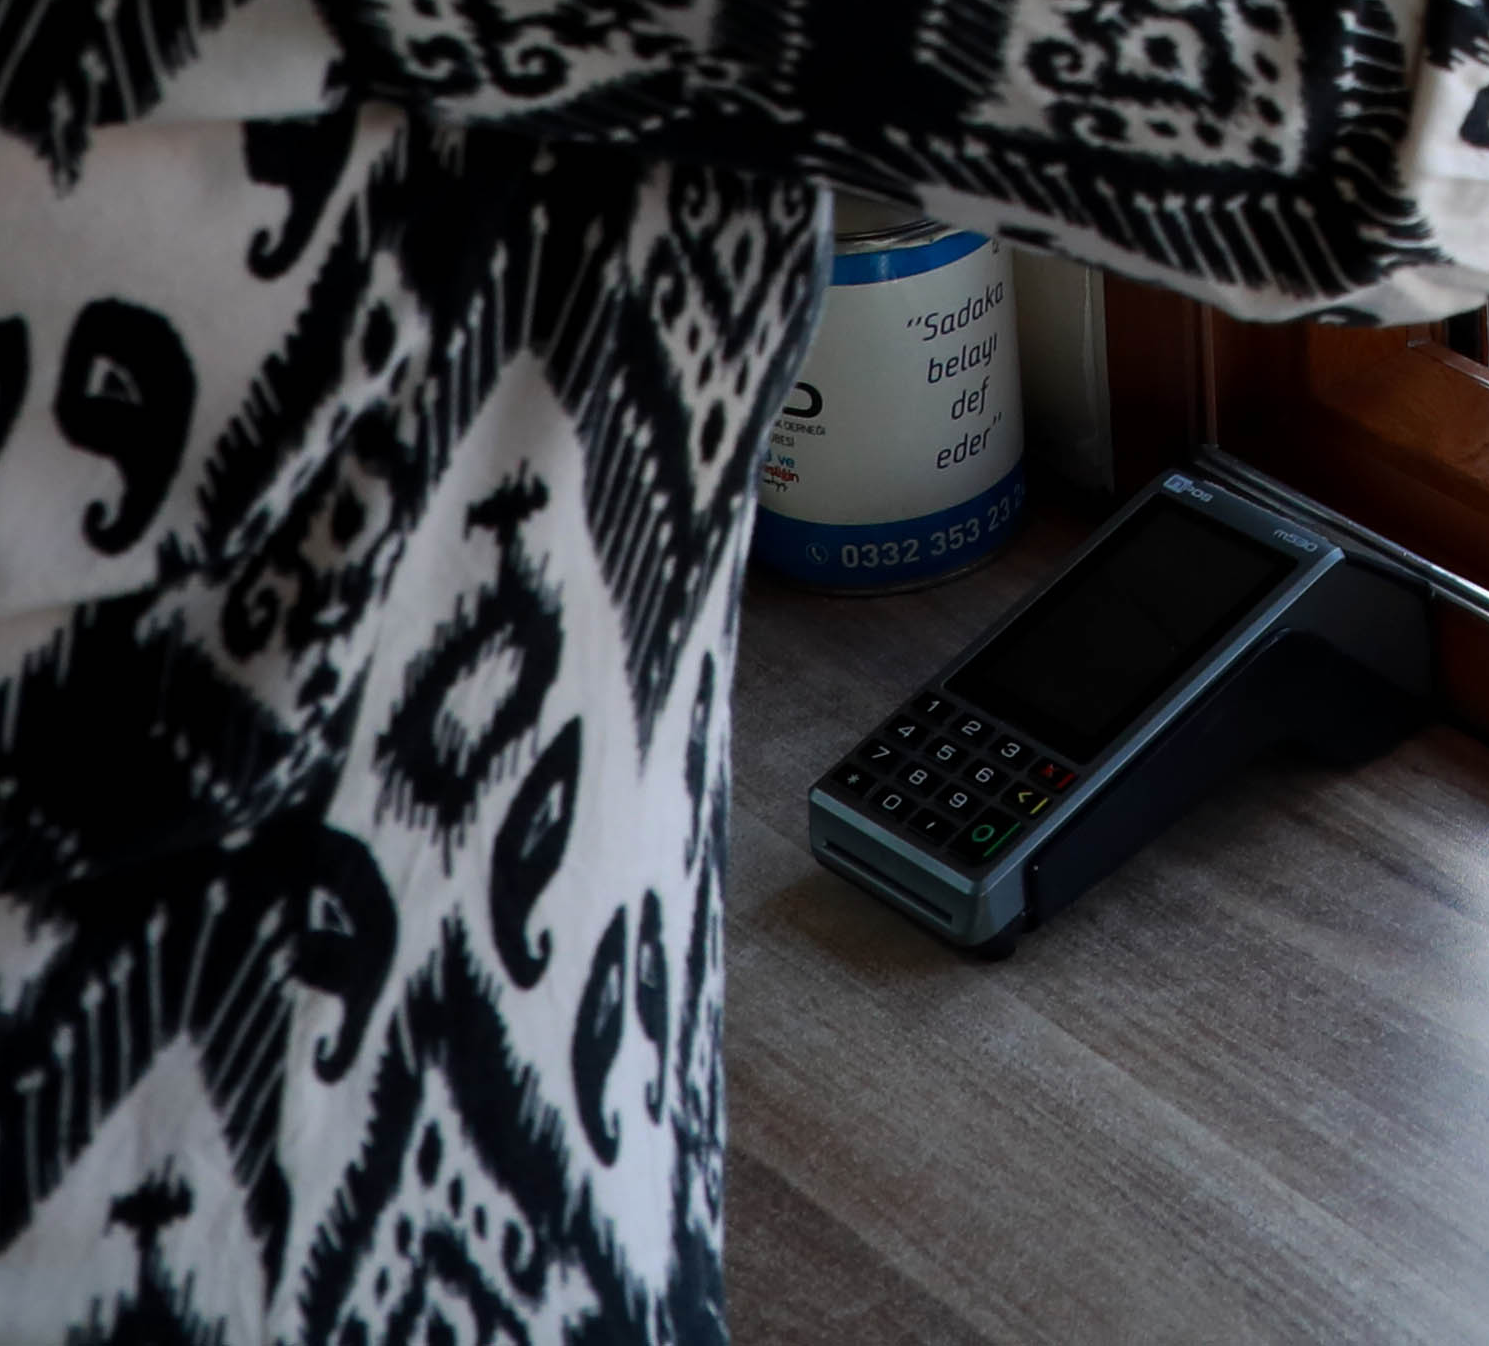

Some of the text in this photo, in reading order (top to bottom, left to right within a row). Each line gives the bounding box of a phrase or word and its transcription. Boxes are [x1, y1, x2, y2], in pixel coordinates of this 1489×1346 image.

[951, 375, 991, 420] def
[841, 497, 1011, 568] 0332 353 23
[897, 725, 995, 783] 4 5 6
[927, 700, 1021, 758] 1 2 3
[871, 746, 968, 808] 7 8 9
[882, 794, 902, 810] 0
